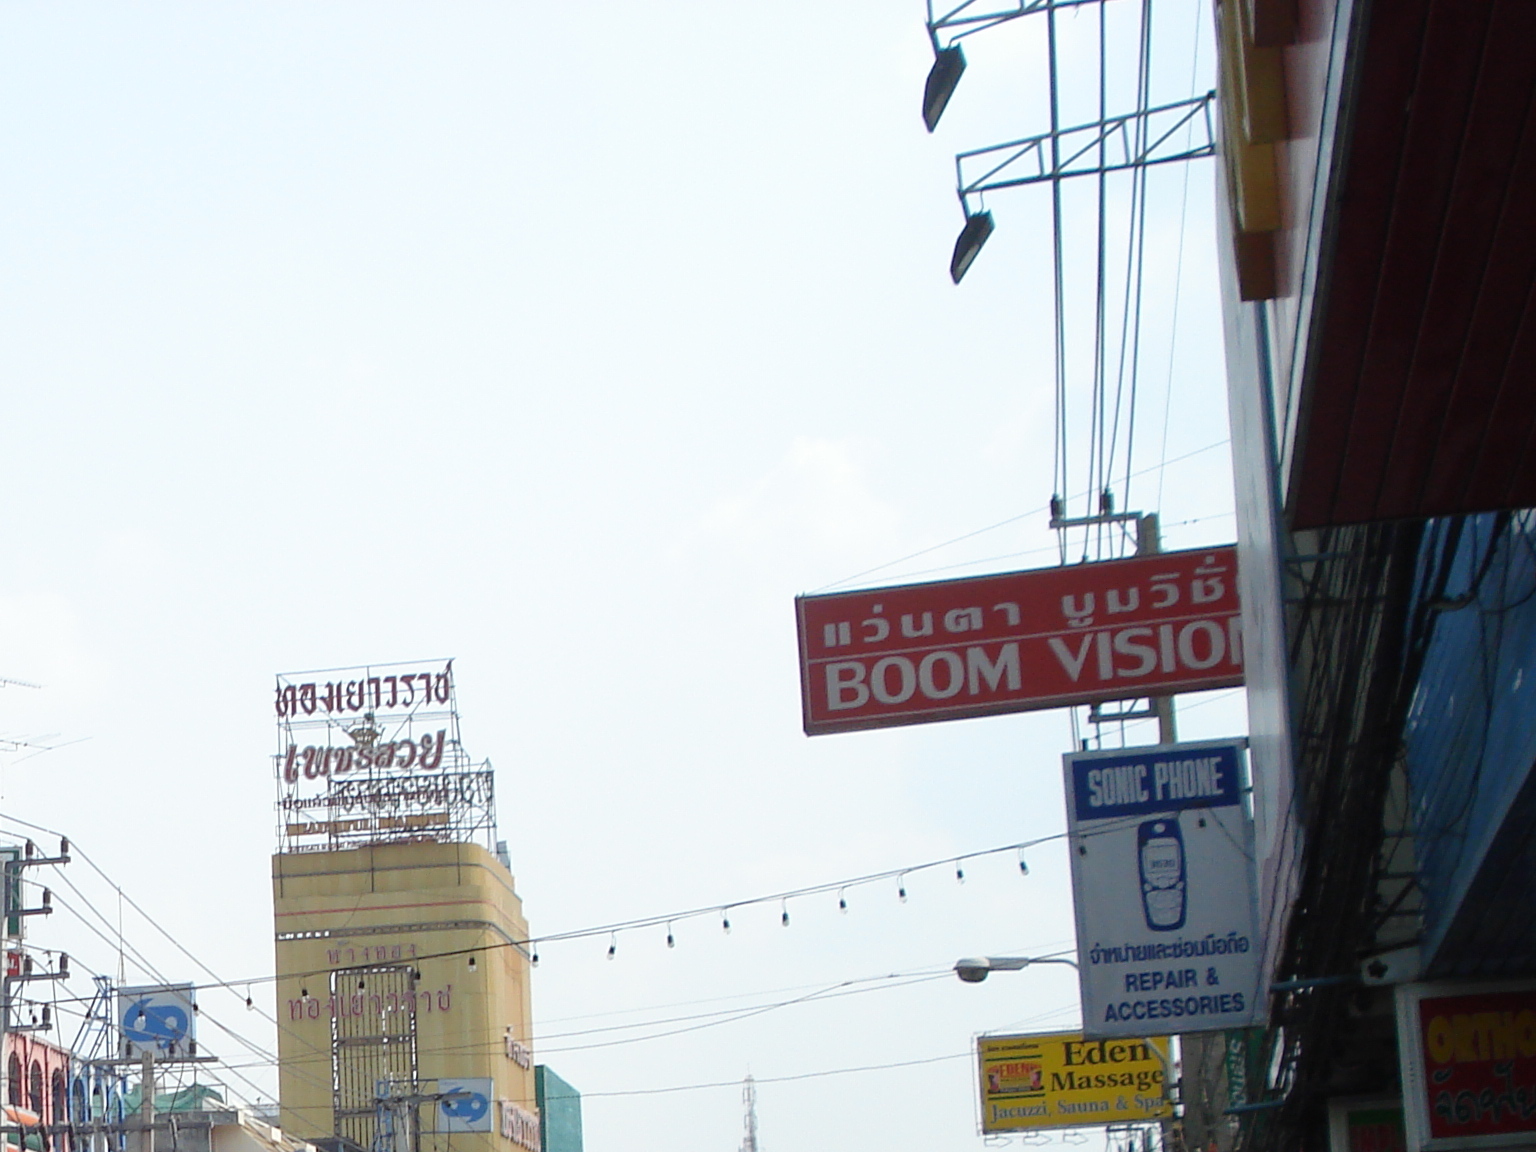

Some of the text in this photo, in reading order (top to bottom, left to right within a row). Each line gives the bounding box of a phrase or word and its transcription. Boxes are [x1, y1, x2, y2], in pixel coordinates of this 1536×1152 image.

[823, 555, 1240, 649] แว่นตา บูมวิชั่
[275, 660, 452, 718] ทองเยาวราช
[824, 642, 1023, 712] BOOM
[1088, 756, 1225, 808] SONIC PHONE
[1126, 967, 1220, 993] REPAIR &
[1105, 992, 1246, 1022] ACCESSORIES
[1062, 1040, 1153, 1067] Eden
[1050, 1068, 1164, 1092] Massage
[990, 1095, 1165, 1124] Jacuzzi, Sauna & Spa
